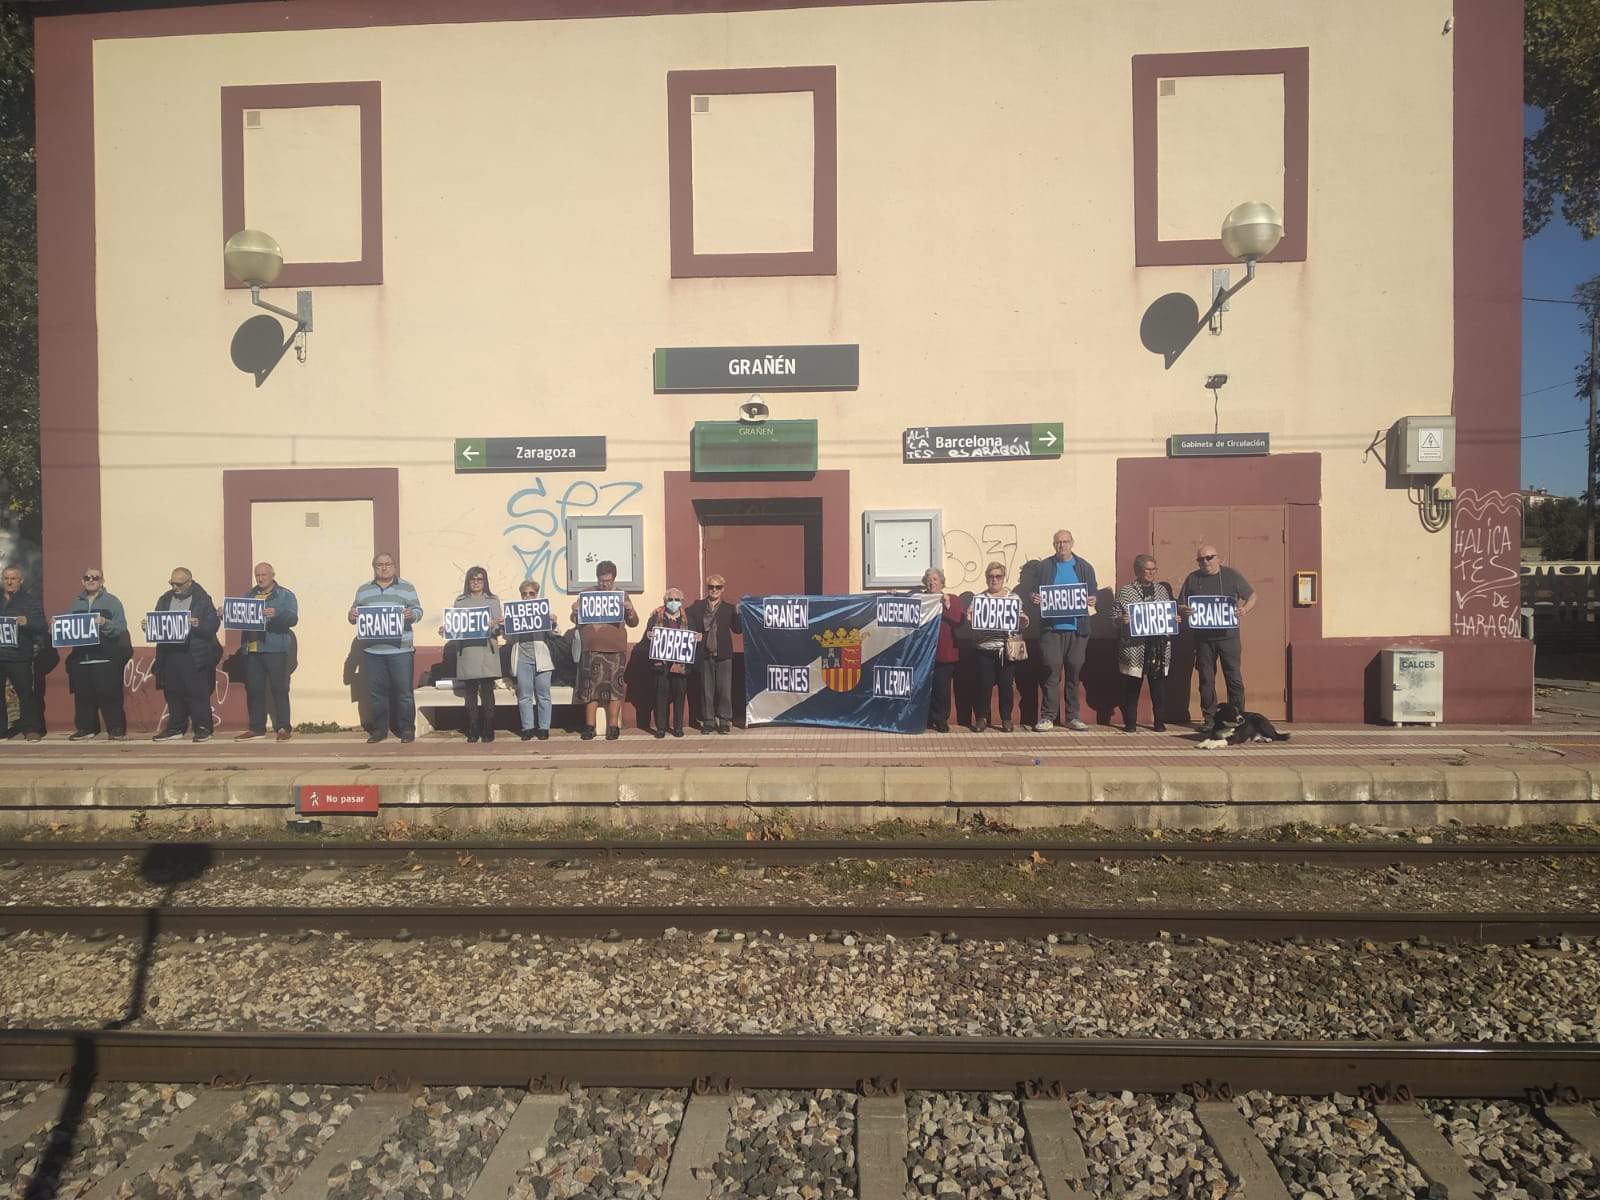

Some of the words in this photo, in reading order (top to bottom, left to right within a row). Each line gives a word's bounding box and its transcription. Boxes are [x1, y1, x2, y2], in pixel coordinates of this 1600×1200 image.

[728, 355, 796, 375] GRAÑÉN
[935, 435, 1003, 449] Barcelona
[1227, 439, 1265, 447] Circulación
[516, 447, 576, 461] Zaragoza
[504, 602, 549, 618] ALBERO
[582, 596, 620, 617] ROBRES
[1041, 588, 1087, 611] BARBUES
[225, 602, 263, 624] ALBERUELA
[358, 608, 404, 636] GRAÑÉN
[445, 611, 490, 633] SODETO
[513, 617, 542, 631] BAJO
[765, 600, 808, 627] GRAÑÉN
[877, 603, 919, 623] QUEREMOS
[973, 598, 1018, 630] ROBRES
[1133, 603, 1173, 634] CURBE
[54, 618, 98, 640] FRULA
[147, 615, 189, 640] VALFONDA
[652, 631, 694, 661] ROBRES
[768, 668, 808, 691] TRENES
[875, 675, 881, 694] A
[884, 671, 911, 696] LERIDA
[326, 795, 338, 803] No
[341, 796, 365, 804] pasar
